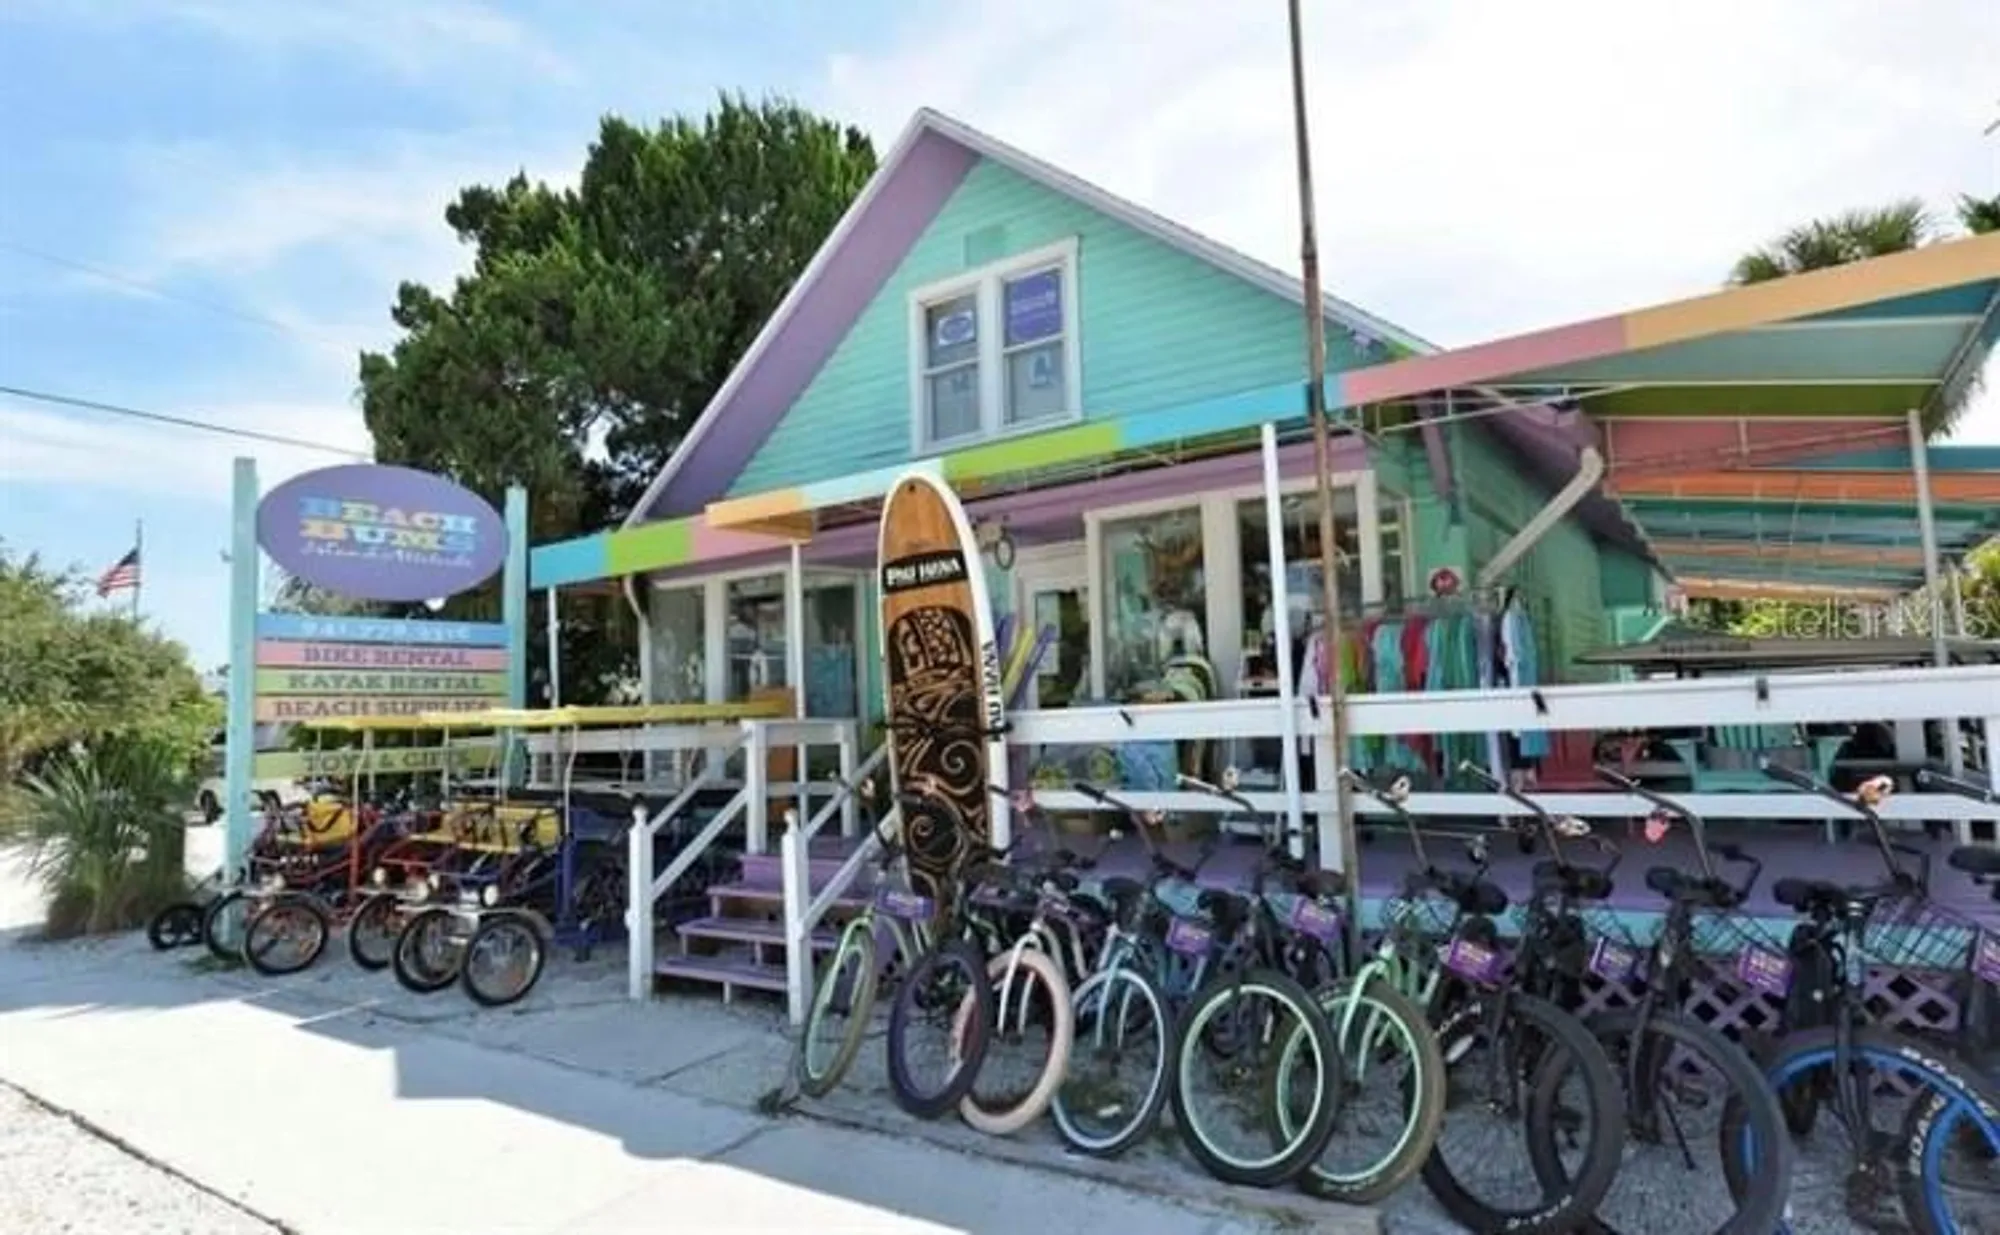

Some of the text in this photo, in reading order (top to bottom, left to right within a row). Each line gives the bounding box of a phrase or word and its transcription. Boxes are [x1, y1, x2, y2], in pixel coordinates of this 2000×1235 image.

[300, 497, 476, 533] BEACH
[300, 519, 475, 552] BUMS
[303, 648, 473, 667] BIKE RENTAL
[287, 674, 487, 691] KAYAK RENTAL
[274, 700, 371, 717] BEACH
